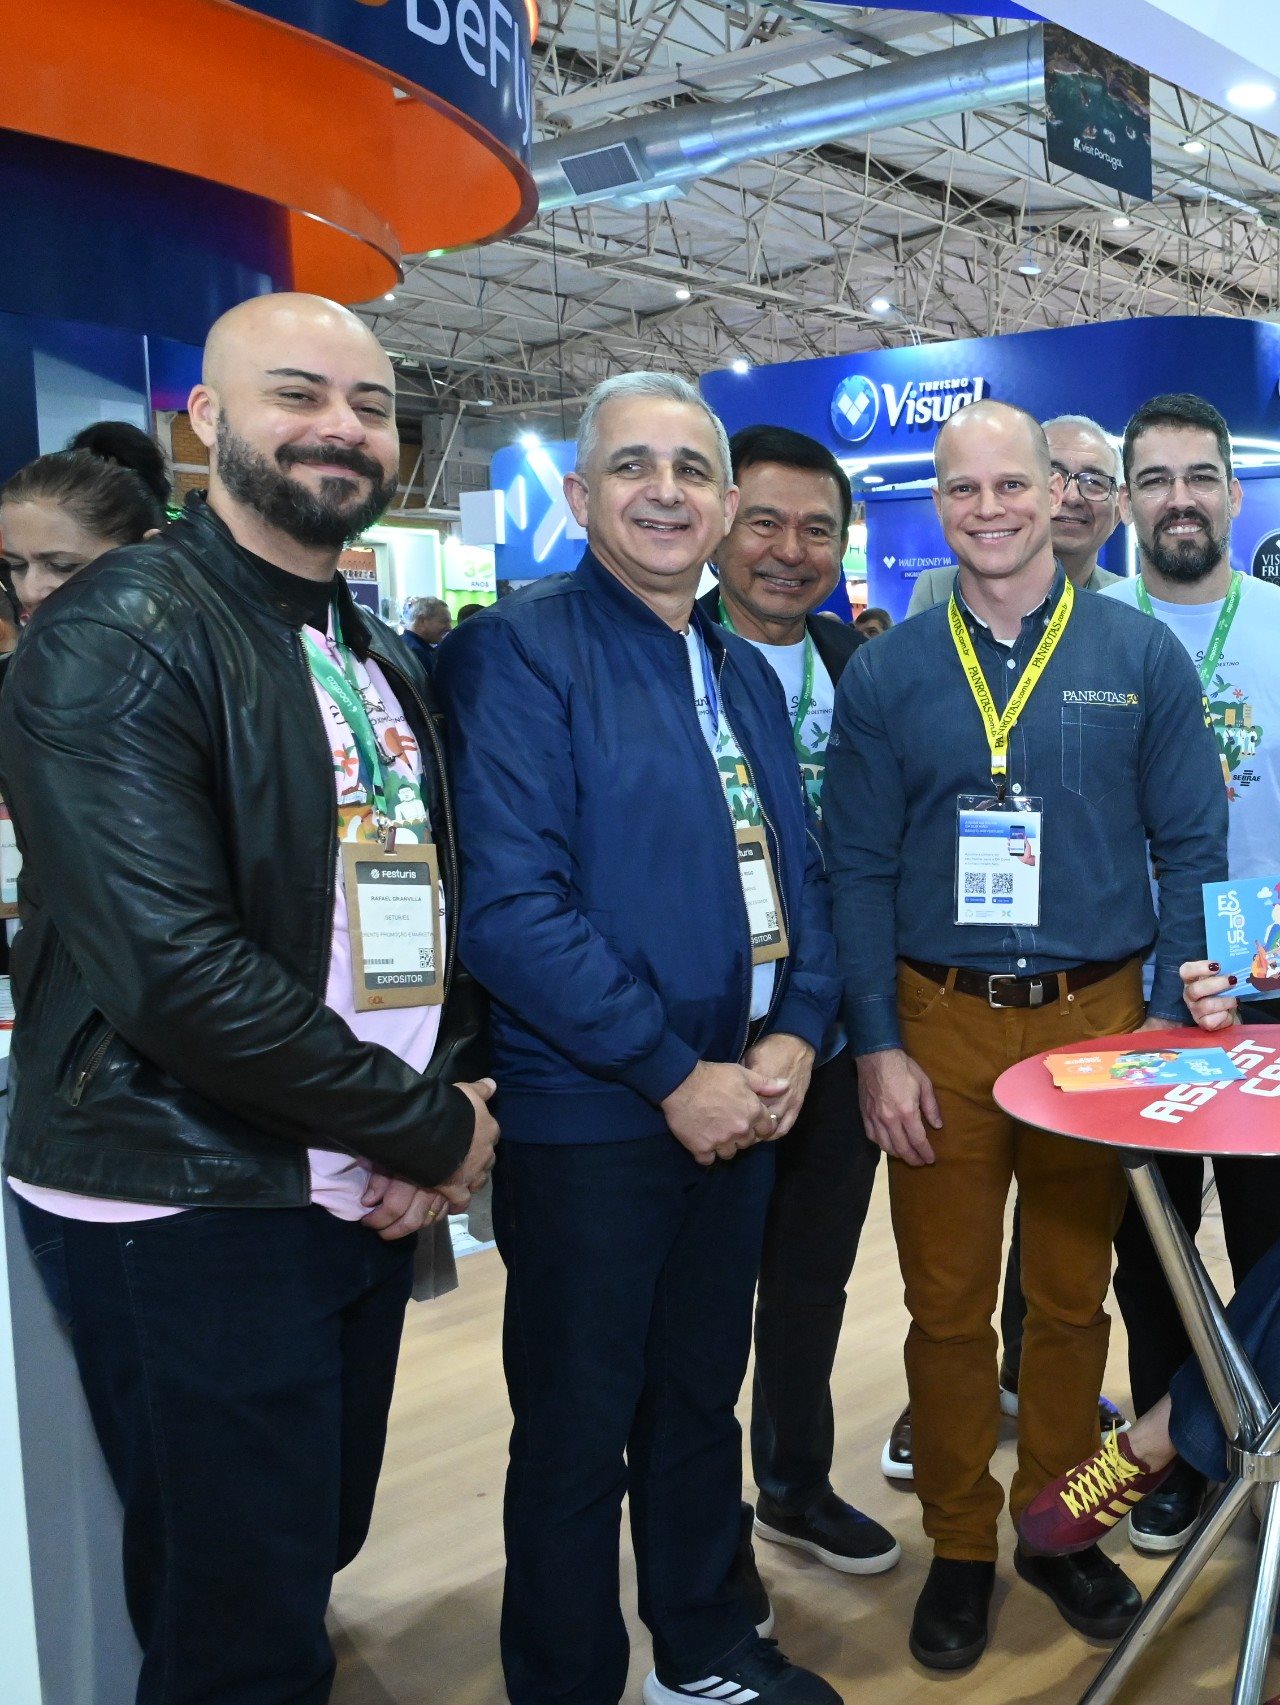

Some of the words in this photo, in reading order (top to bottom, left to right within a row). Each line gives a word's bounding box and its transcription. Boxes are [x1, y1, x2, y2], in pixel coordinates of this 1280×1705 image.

[918, 377, 969, 392] TURISMO
[898, 557, 917, 567] WALT
[916, 556, 943, 567] DISNEY
[1031, 602, 1069, 669] PANROTAS.com.br
[967, 665, 998, 737] PANROTAS.com.b
[1062, 690, 1127, 704] PANROTAS
[1232, 774, 1262, 782] SEBRAE
[1217, 890, 1241, 911] ES
[1227, 929, 1250, 945] UR
[377, 974, 423, 985] EXPOSITOR
